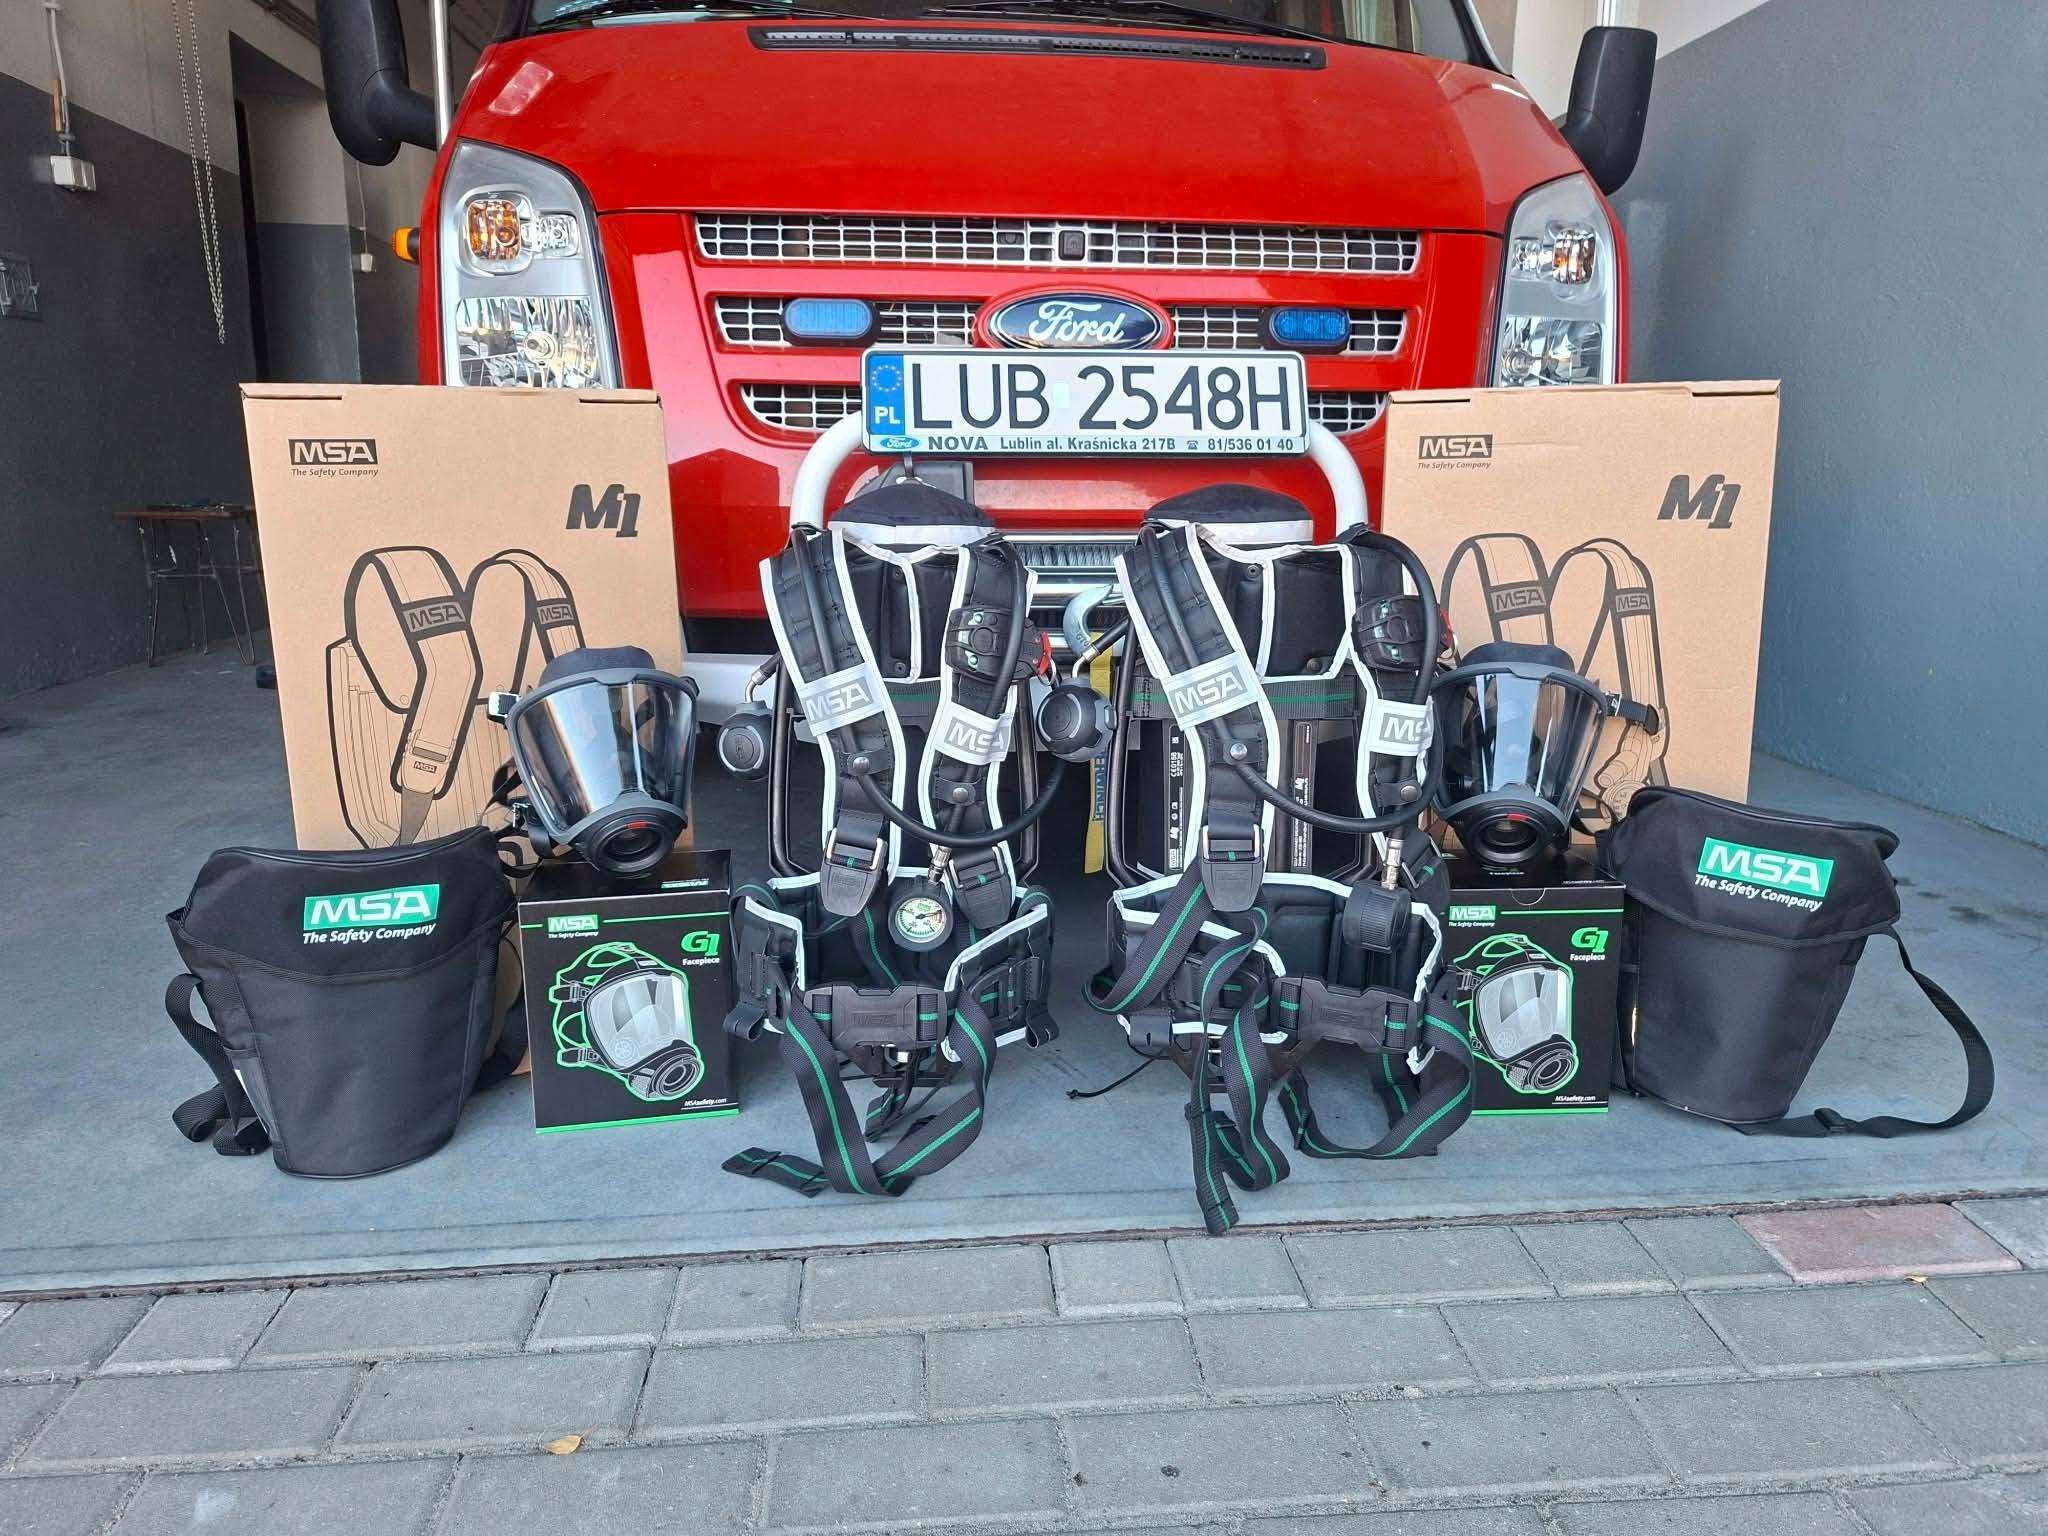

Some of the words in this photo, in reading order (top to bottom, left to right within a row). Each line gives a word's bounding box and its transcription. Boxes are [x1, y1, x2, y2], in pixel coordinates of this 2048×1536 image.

[1028, 300, 1125, 343] Ford
[912, 363, 1050, 430] LUB
[1076, 365, 1291, 431] 2548H
[874, 405, 901, 425] PL
[293, 441, 376, 463] MSA
[886, 437, 912, 449] Ford
[928, 436, 989, 450] NOVA
[1000, 437, 1042, 450] Lublin
[1046, 437, 1063, 450] al.
[1067, 437, 1137, 450] Kraśnicka
[1142, 438, 1176, 450] 217B
[1208, 438, 1252, 452] 81/536
[1256, 438, 1272, 450] 01
[1277, 438, 1294, 450] 40
[1421, 437, 1489, 457] MSA
[291, 468, 307, 476] The
[309, 468, 337, 478] Safety
[338, 468, 379, 478] Company
[1431, 462, 1455, 470] Safety
[1456, 461, 1491, 470] Company
[565, 484, 641, 538] M1
[1657, 474, 1742, 529] M1
[1495, 589, 1545, 611] MSA
[1617, 596, 1649, 610] MSA
[408, 604, 464, 630] MSA
[540, 605, 573, 622] MSA
[805, 682, 871, 721] MSA
[1174, 671, 1244, 714] MSA
[1705, 844, 1820, 892] MSA
[1695, 873, 1717, 889] The
[1718, 879, 1762, 900] Safety
[1761, 888, 1823, 913] Company
[310, 890, 432, 925] MSA
[1451, 906, 1495, 920] MSA
[303, 931, 327, 945] The
[329, 928, 374, 945] Safety
[375, 923, 437, 940] Company
[549, 916, 596, 932] MSA
[681, 930, 720, 957] G1
[1571, 926, 1609, 953] G1
[682, 957, 720, 966] Facepiece
[1570, 953, 1606, 963] Facepiece
